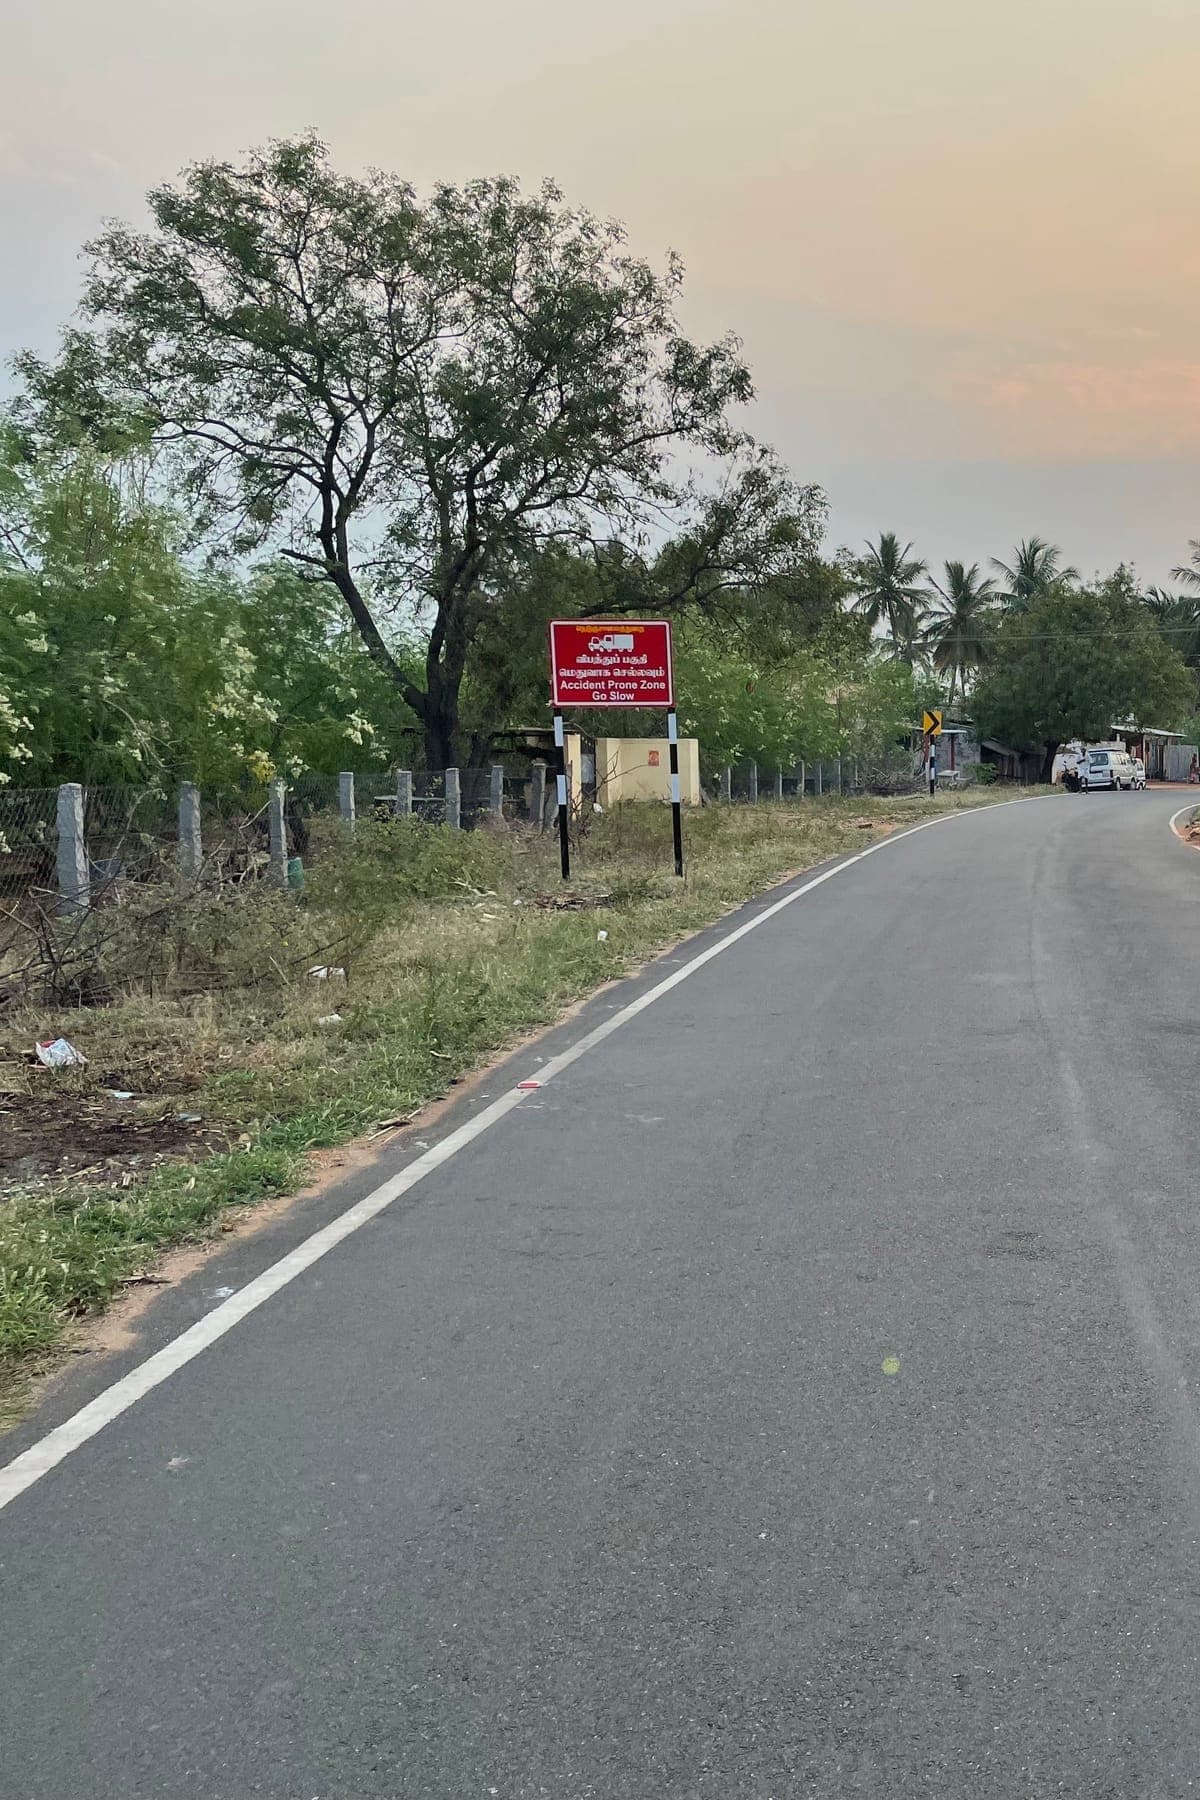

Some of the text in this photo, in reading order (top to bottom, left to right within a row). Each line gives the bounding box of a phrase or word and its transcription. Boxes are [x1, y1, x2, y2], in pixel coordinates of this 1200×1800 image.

[623, 654, 648, 665] பகுதி
[560, 680, 666, 690] Accident Prone Zone
[592, 692, 634, 700] Go Slow
